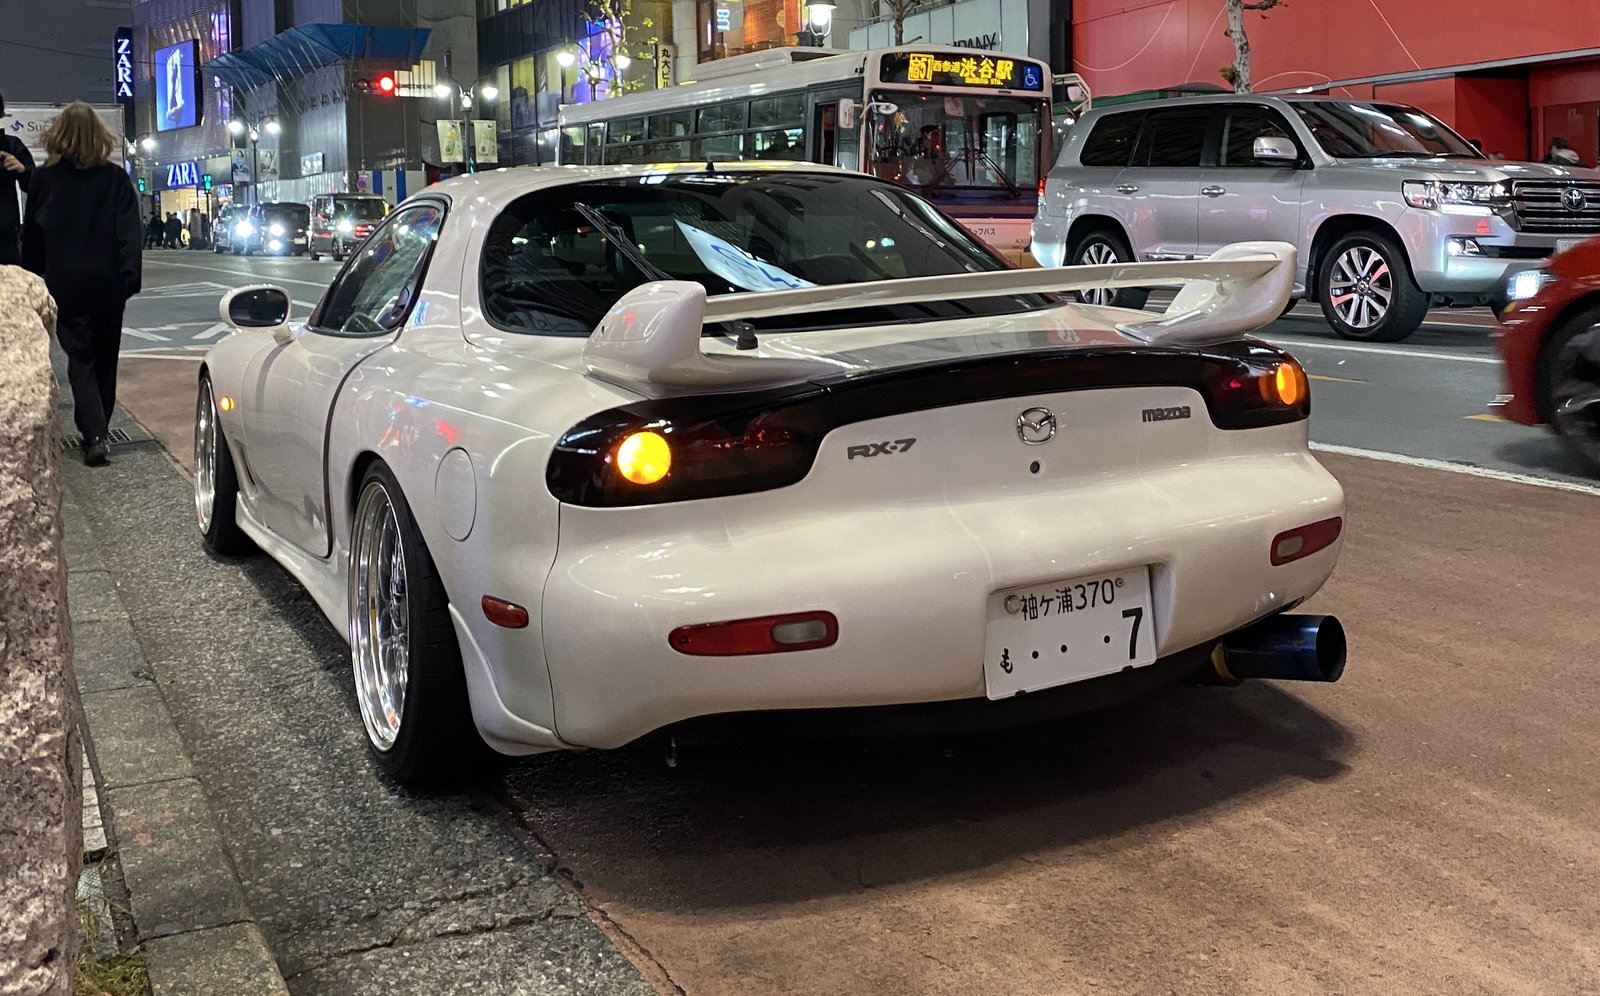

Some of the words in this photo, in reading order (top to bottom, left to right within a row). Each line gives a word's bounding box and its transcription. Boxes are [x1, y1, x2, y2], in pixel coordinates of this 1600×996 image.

[945, 32, 997, 50] PANY
[117, 38, 133, 97] ZARA
[959, 57, 1014, 81] 渋谷駅
[27, 121, 42, 132] Su
[167, 162, 198, 187] ZARA
[969, 227, 996, 236] ップバス
[847, 437, 917, 460] RX-7
[1000, 648, 1013, 674] も
